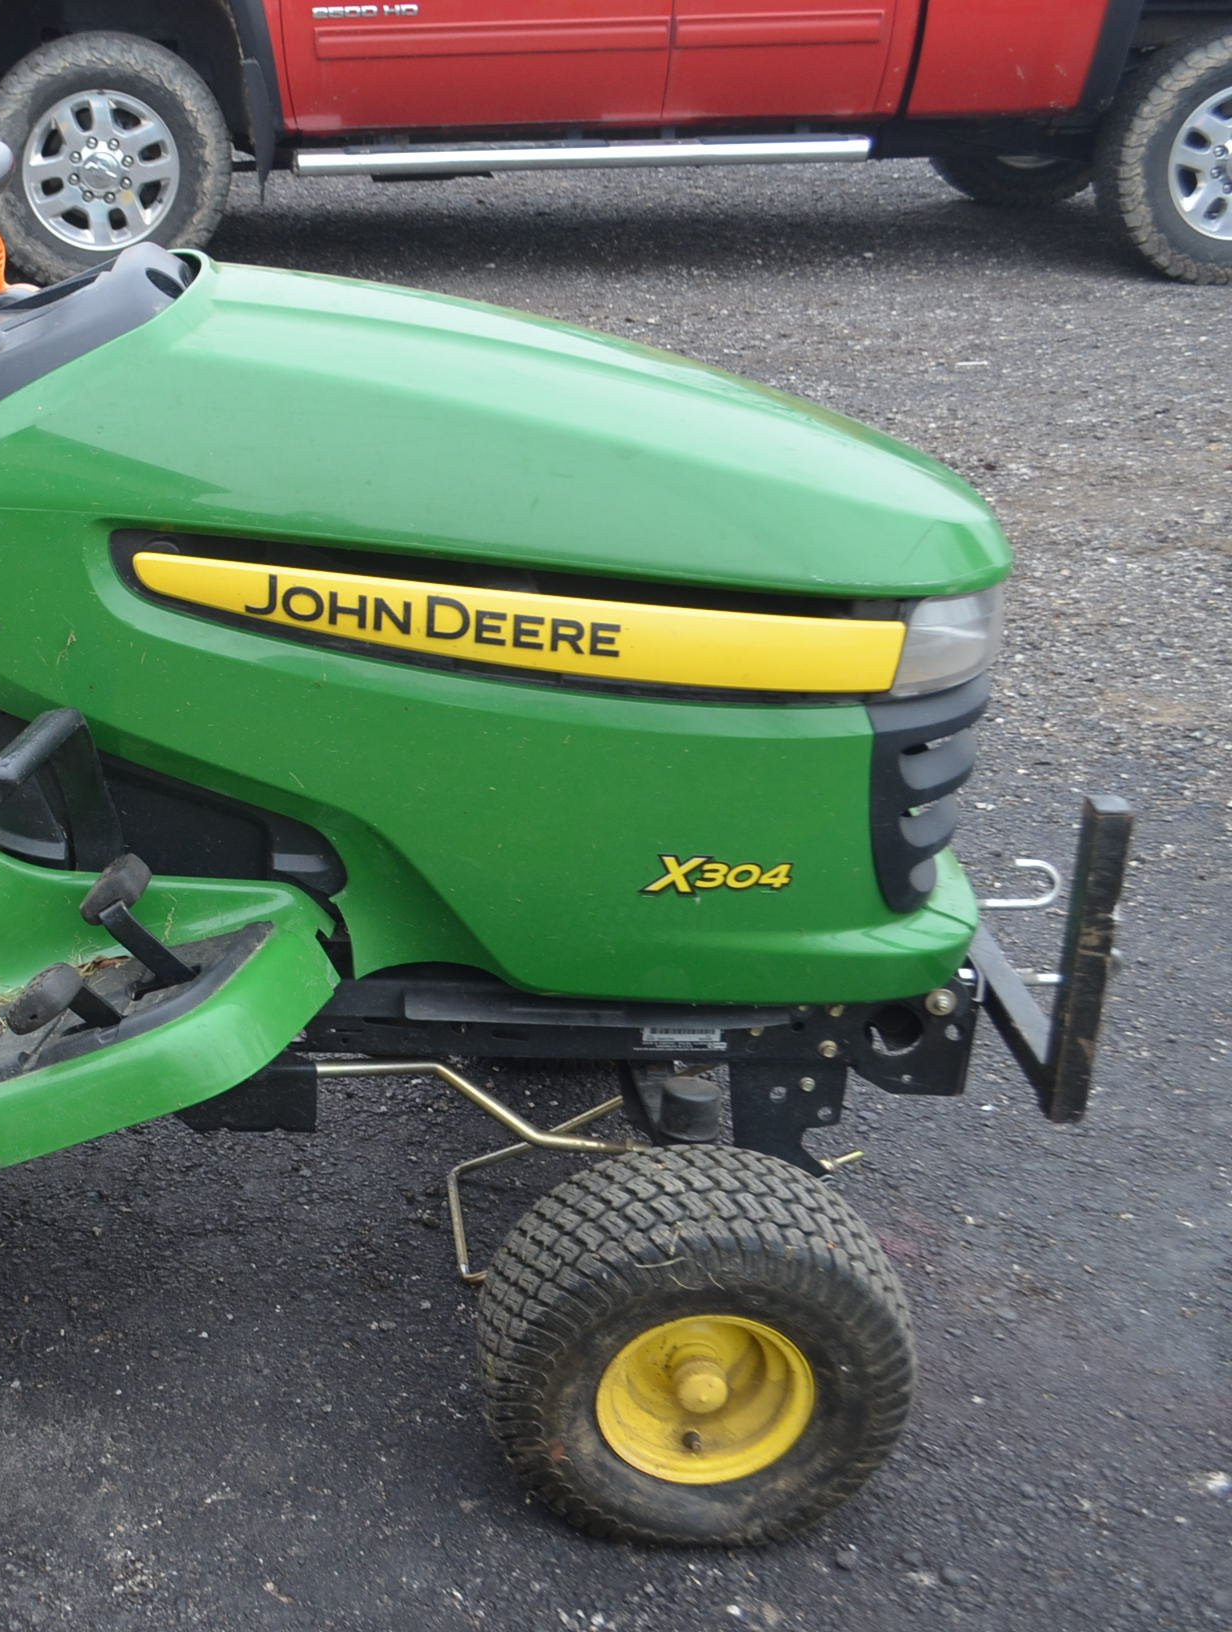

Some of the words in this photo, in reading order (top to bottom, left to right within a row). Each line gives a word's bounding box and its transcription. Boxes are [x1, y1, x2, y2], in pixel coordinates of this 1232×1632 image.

[244, 573, 413, 636] JOHN
[424, 595, 622, 659] DEERE
[639, 854, 794, 895] X304
